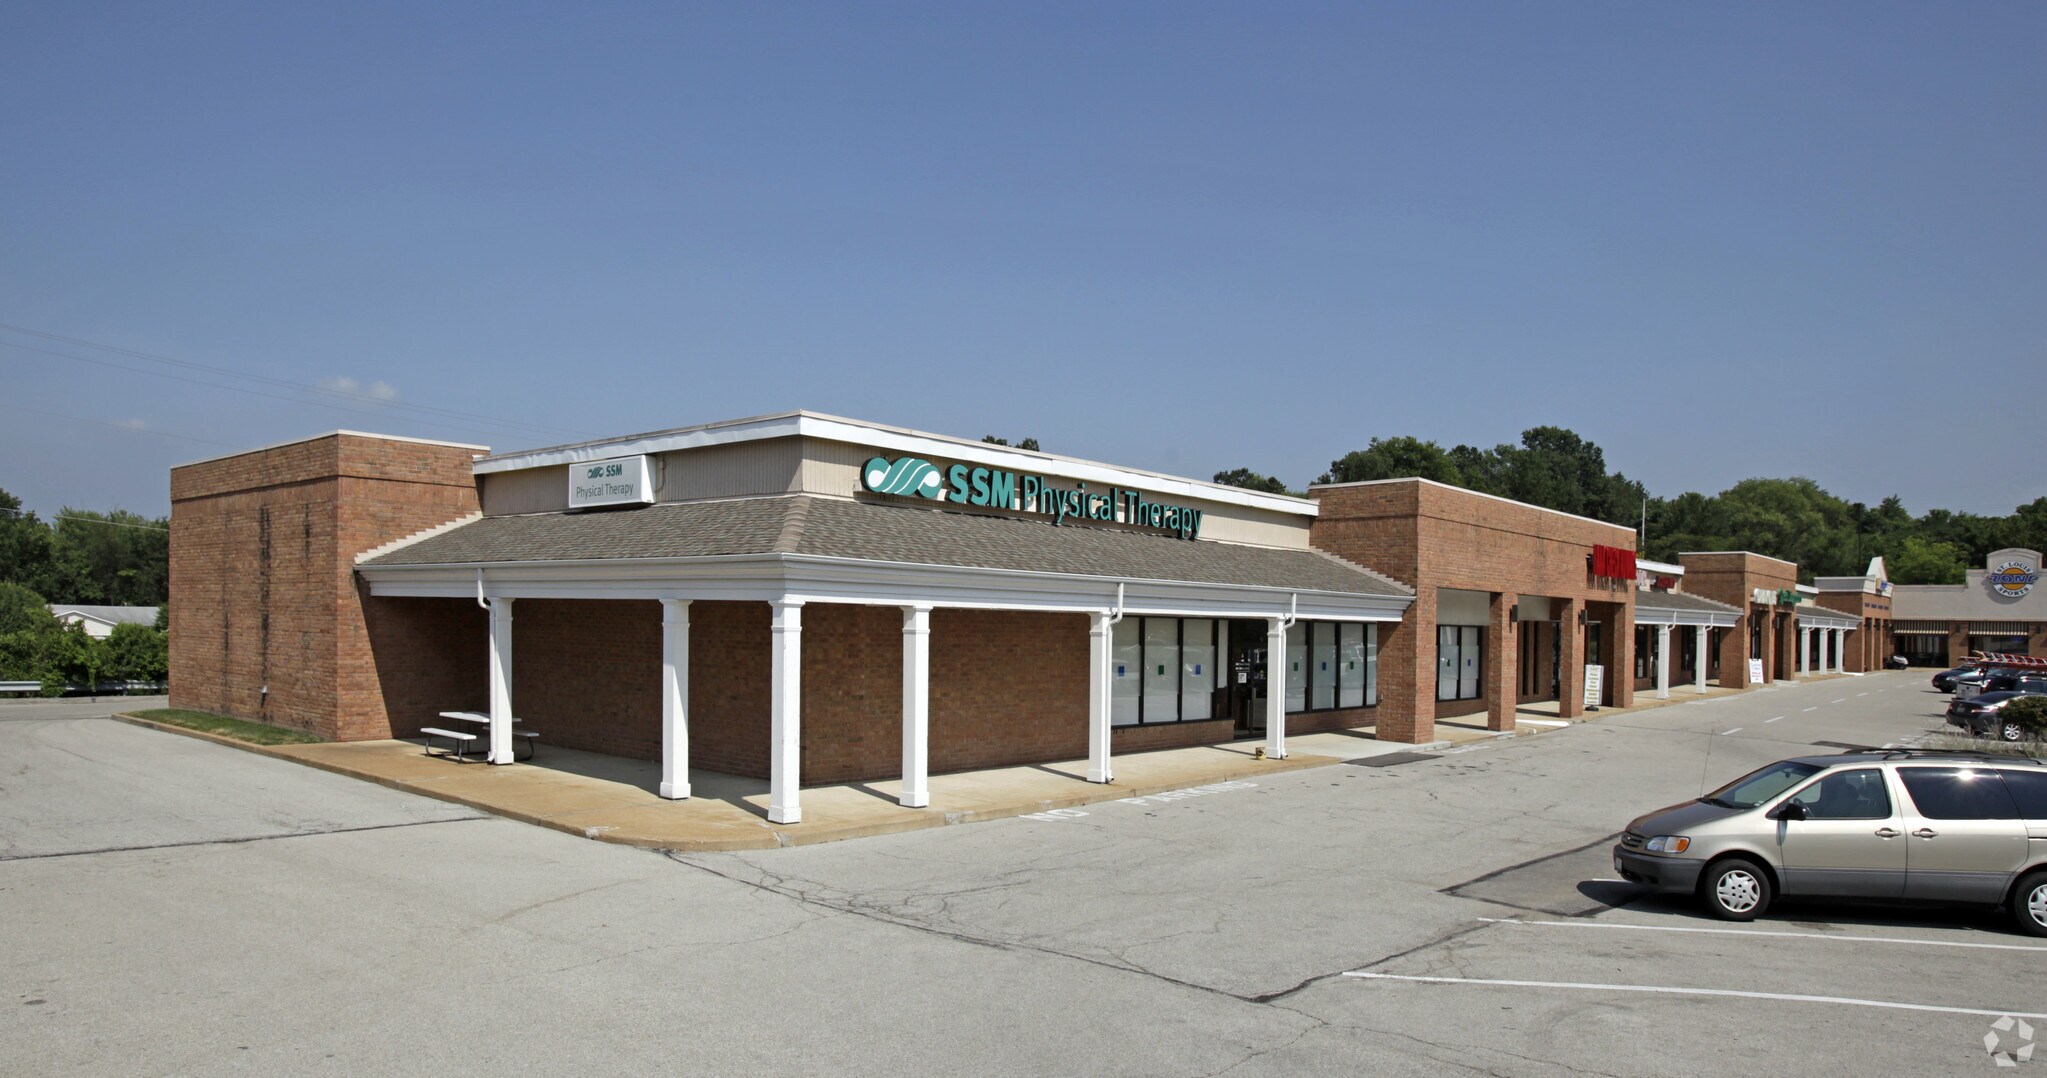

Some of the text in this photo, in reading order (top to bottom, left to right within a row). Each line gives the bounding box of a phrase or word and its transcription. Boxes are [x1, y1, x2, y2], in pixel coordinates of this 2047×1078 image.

[606, 464, 622, 477] SSM
[576, 484, 634, 499] Physical Therapy
[947, 463, 1203, 541] SSM Physical Therapy
[2008, 562, 2031, 572] LOUIS
[1998, 587, 2029, 596] SPORTS
